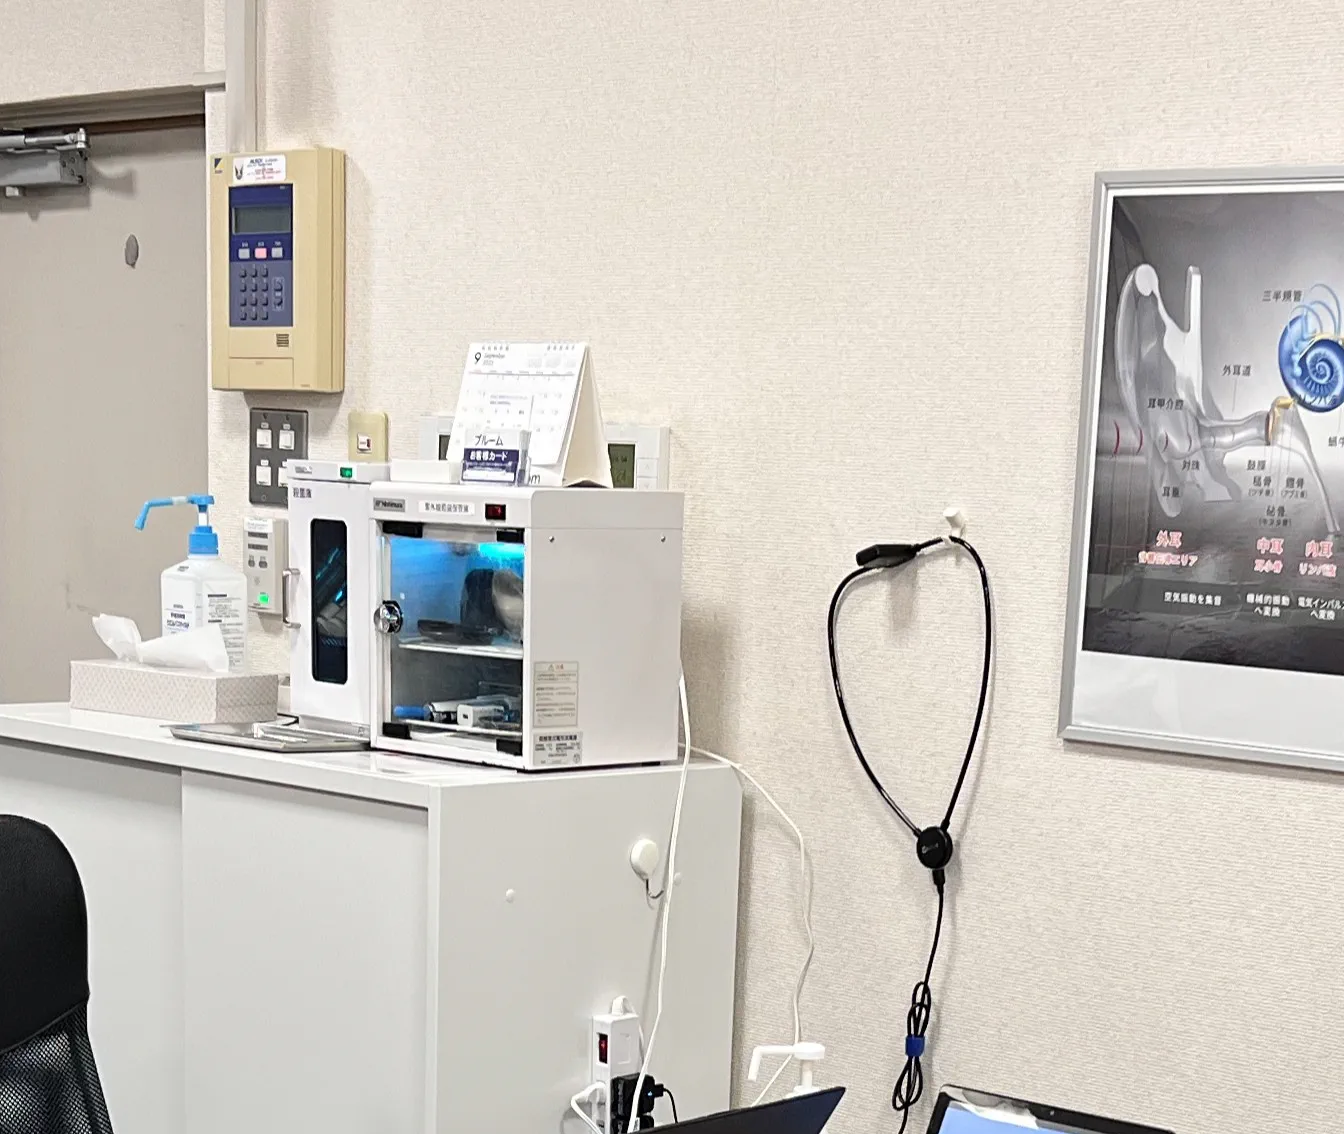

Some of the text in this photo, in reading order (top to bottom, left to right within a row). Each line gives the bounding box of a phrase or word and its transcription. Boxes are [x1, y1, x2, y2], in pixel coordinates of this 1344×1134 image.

[1262, 290, 1303, 302] 三半規管
[474, 352, 482, 365] 9
[1222, 364, 1252, 377] 外耳道
[475, 433, 504, 446] ブルーム
[1156, 529, 1183, 549] 外耳
[1256, 536, 1285, 556] 中耳
[1305, 539, 1334, 559] 内耳
[1246, 593, 1290, 606] 機械的振動
[1254, 606, 1281, 618] へ変換
[1310, 609, 1336, 621] へ変換
